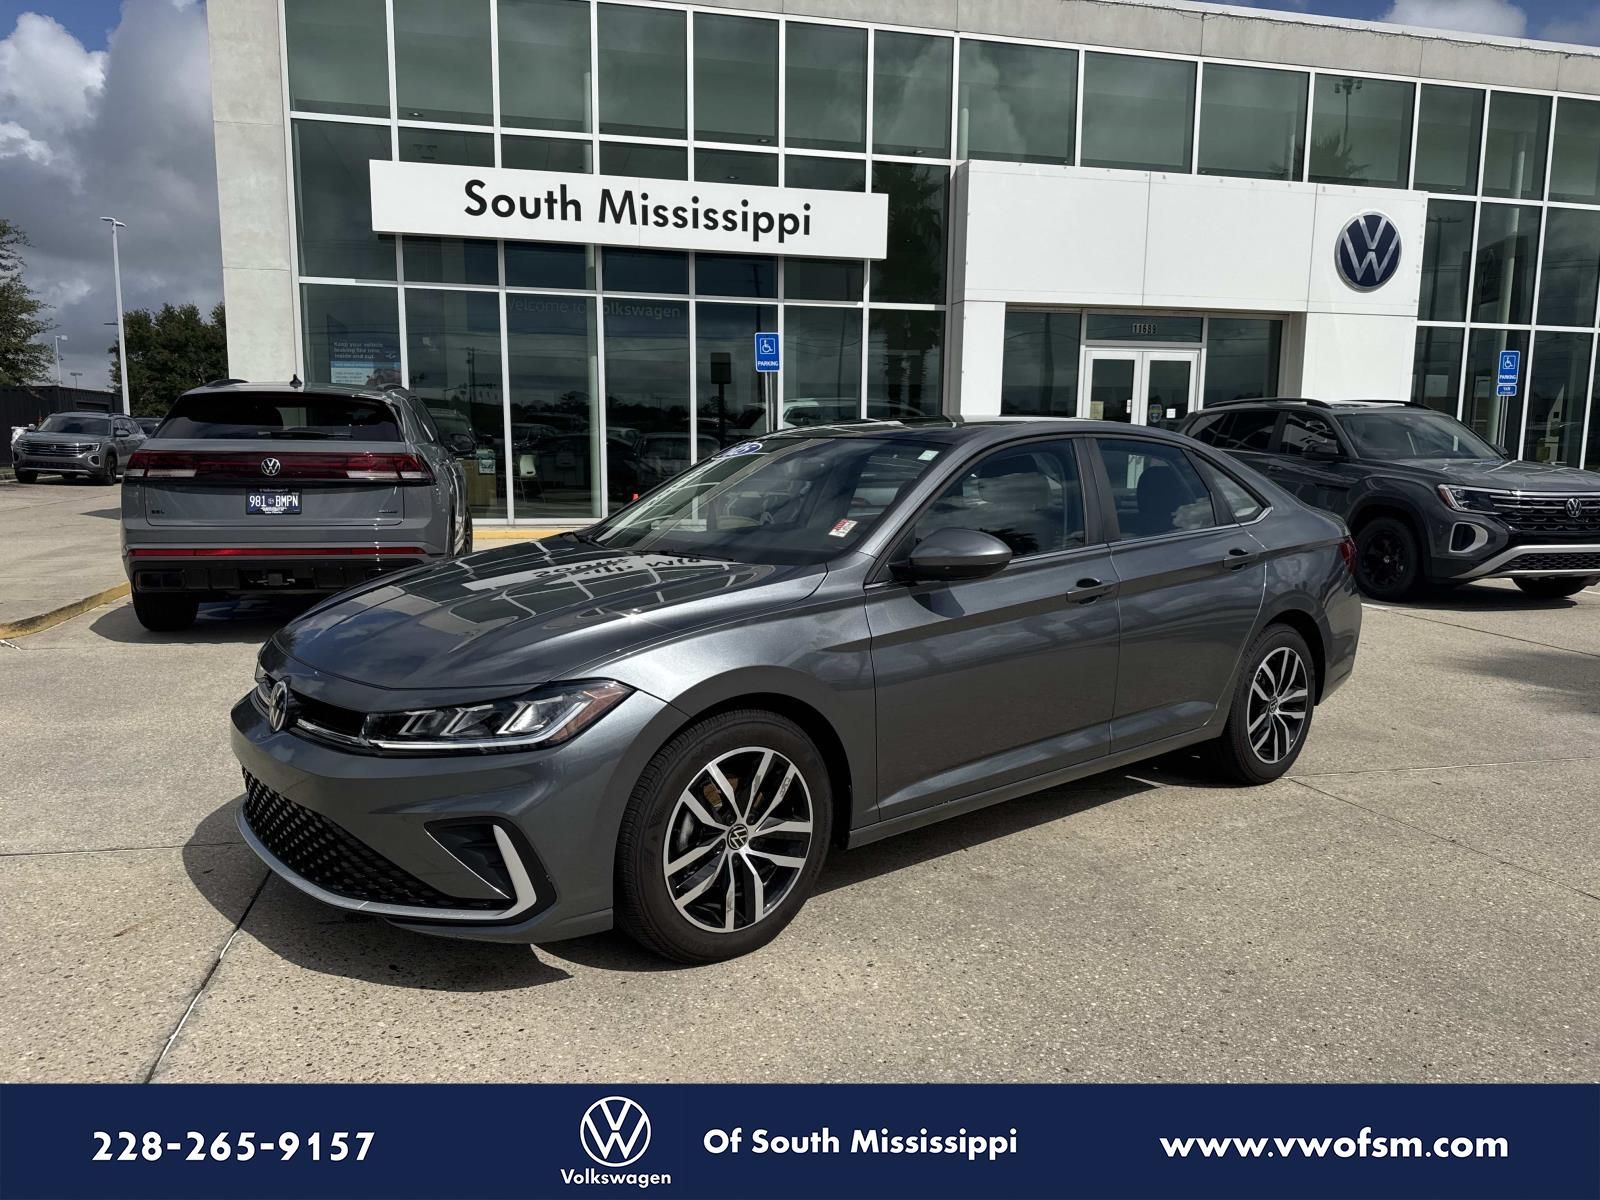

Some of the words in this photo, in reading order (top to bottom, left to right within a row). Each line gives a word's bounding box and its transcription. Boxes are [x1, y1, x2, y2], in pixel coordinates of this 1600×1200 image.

[465, 180, 581, 222] South
[598, 188, 811, 244] Mississippi
[603, 301, 681, 321] olkswagen
[249, 495, 267, 507] 981
[275, 495, 299, 507] BMPN
